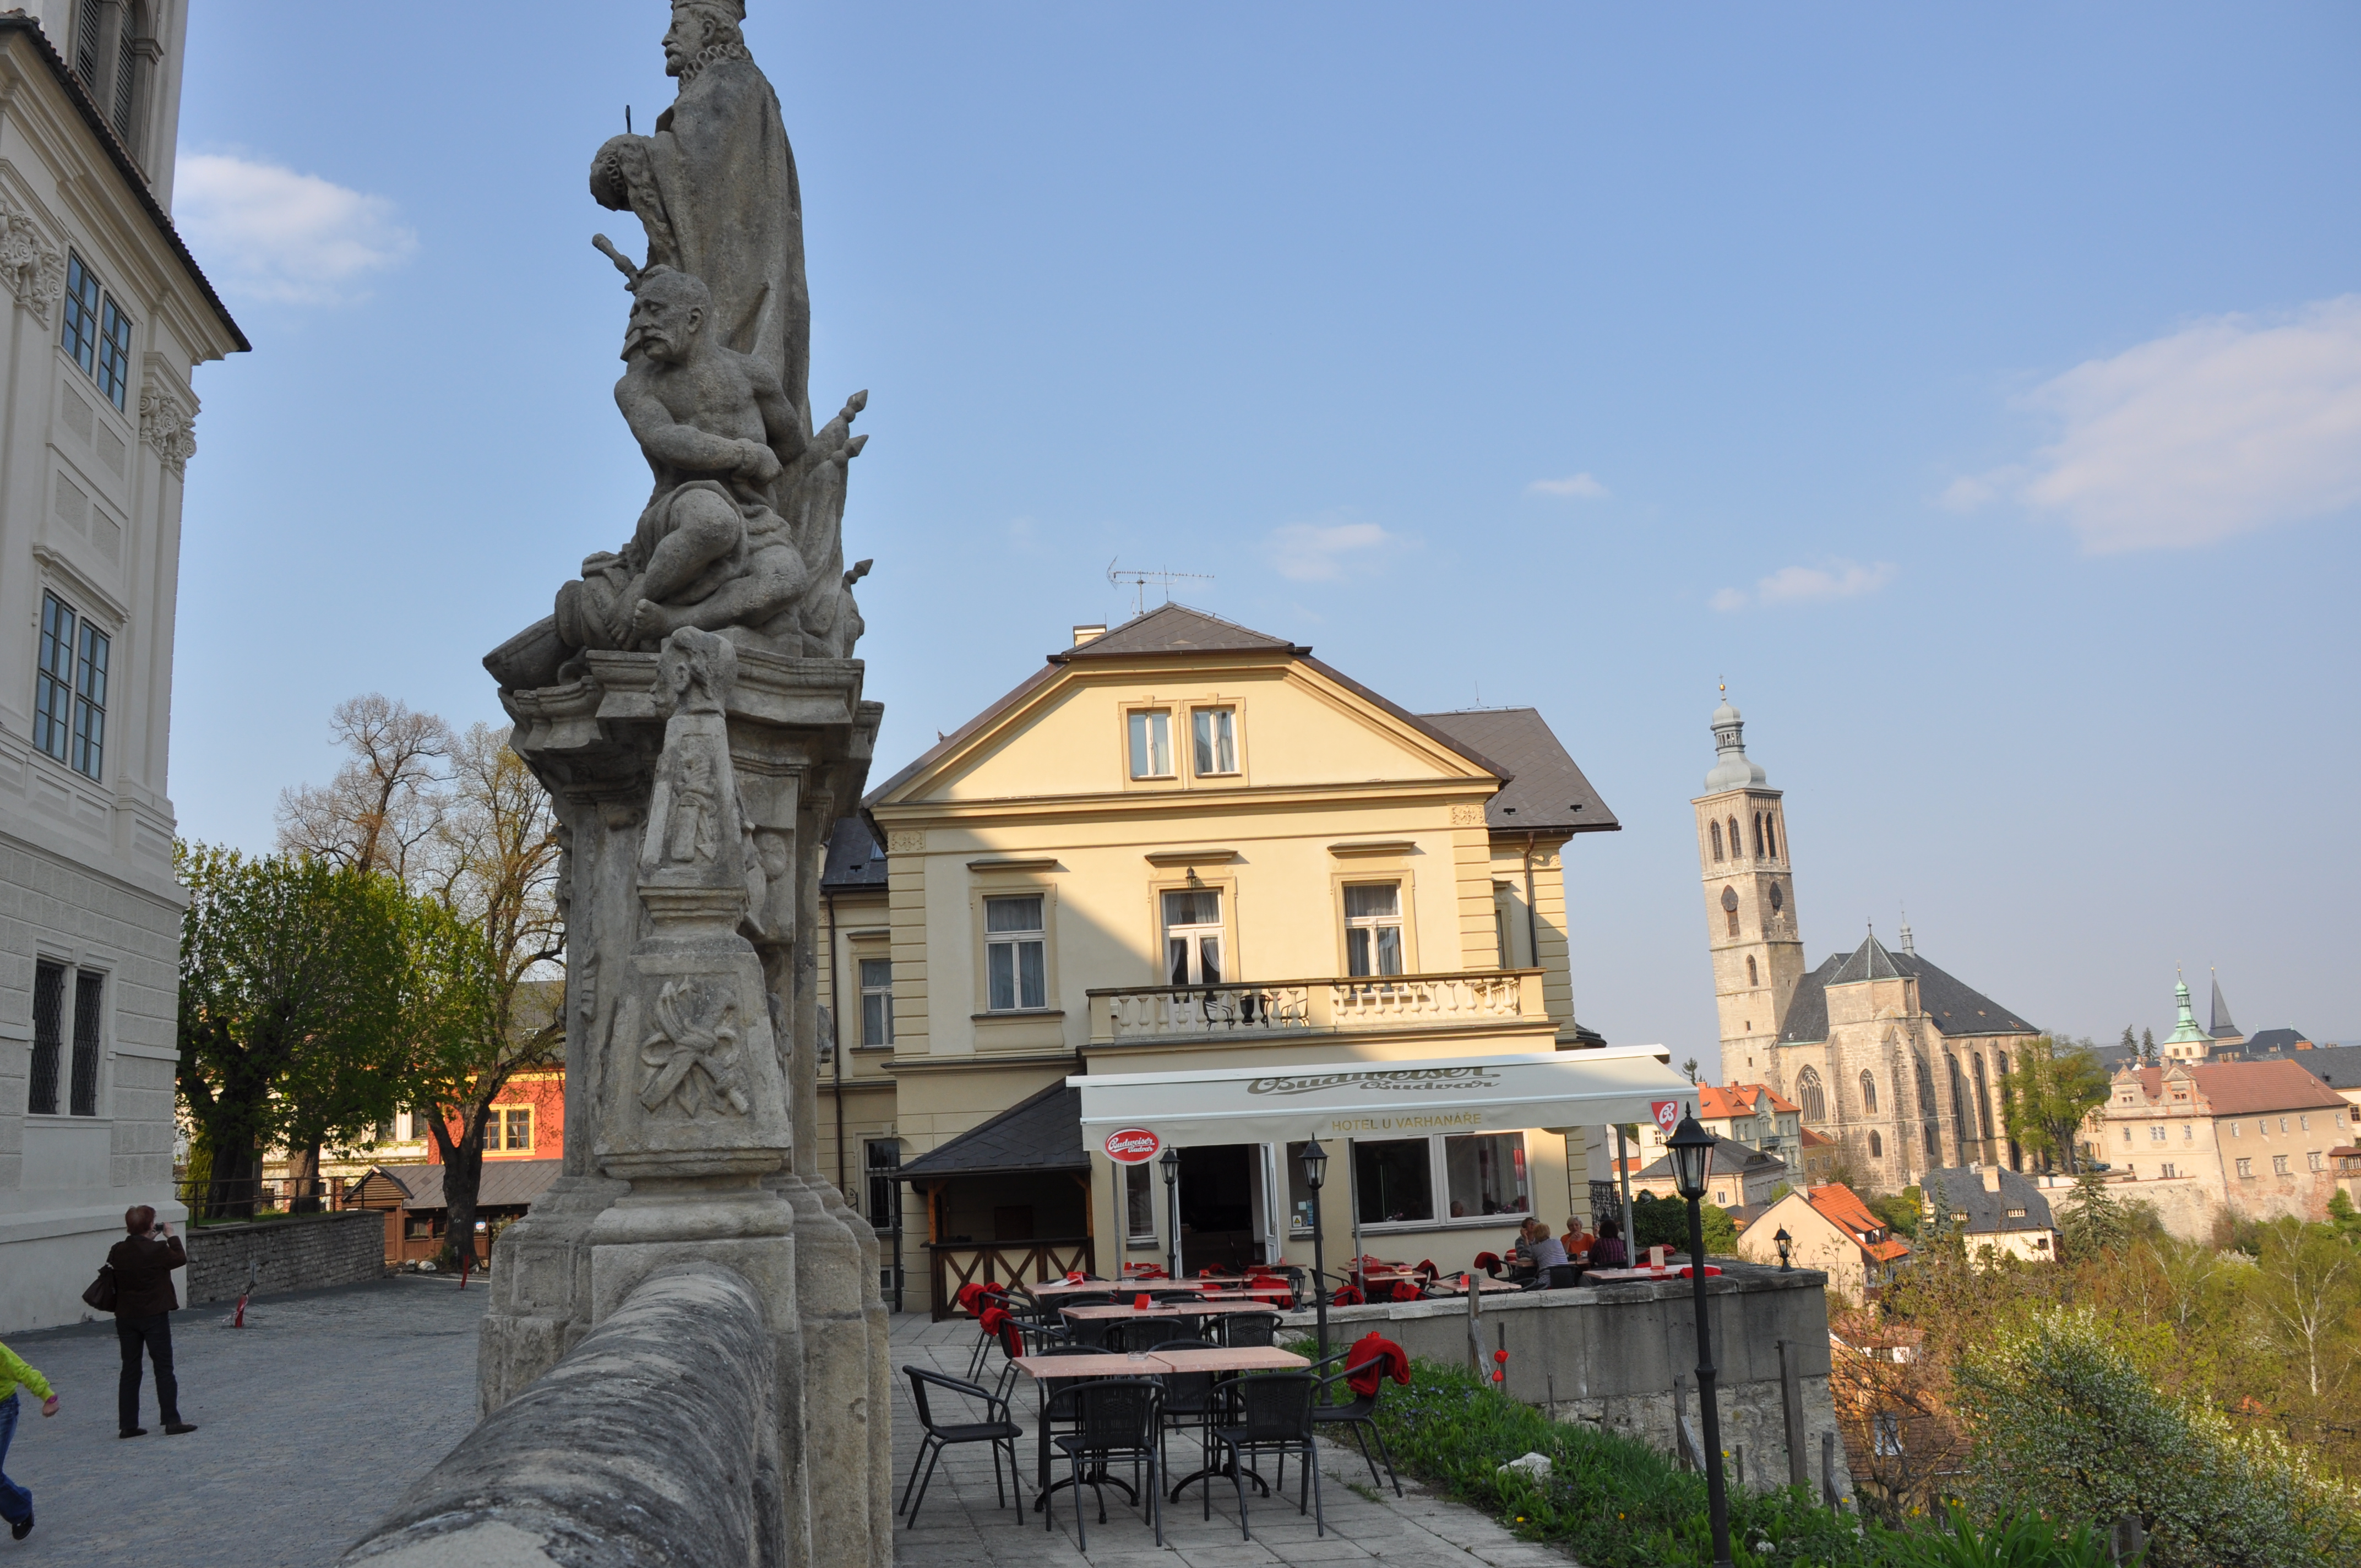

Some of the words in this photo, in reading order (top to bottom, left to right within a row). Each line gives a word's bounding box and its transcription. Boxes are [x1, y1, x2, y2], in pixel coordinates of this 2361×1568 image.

[1359, 1080, 1500, 1090] Budvar
[1332, 1119, 1378, 1131] HOTEL
[1383, 1118, 1391, 1129] U
[1395, 1112, 1482, 1129] VARHANÁŘE
[1108, 1137, 1155, 1153] Budweiser
